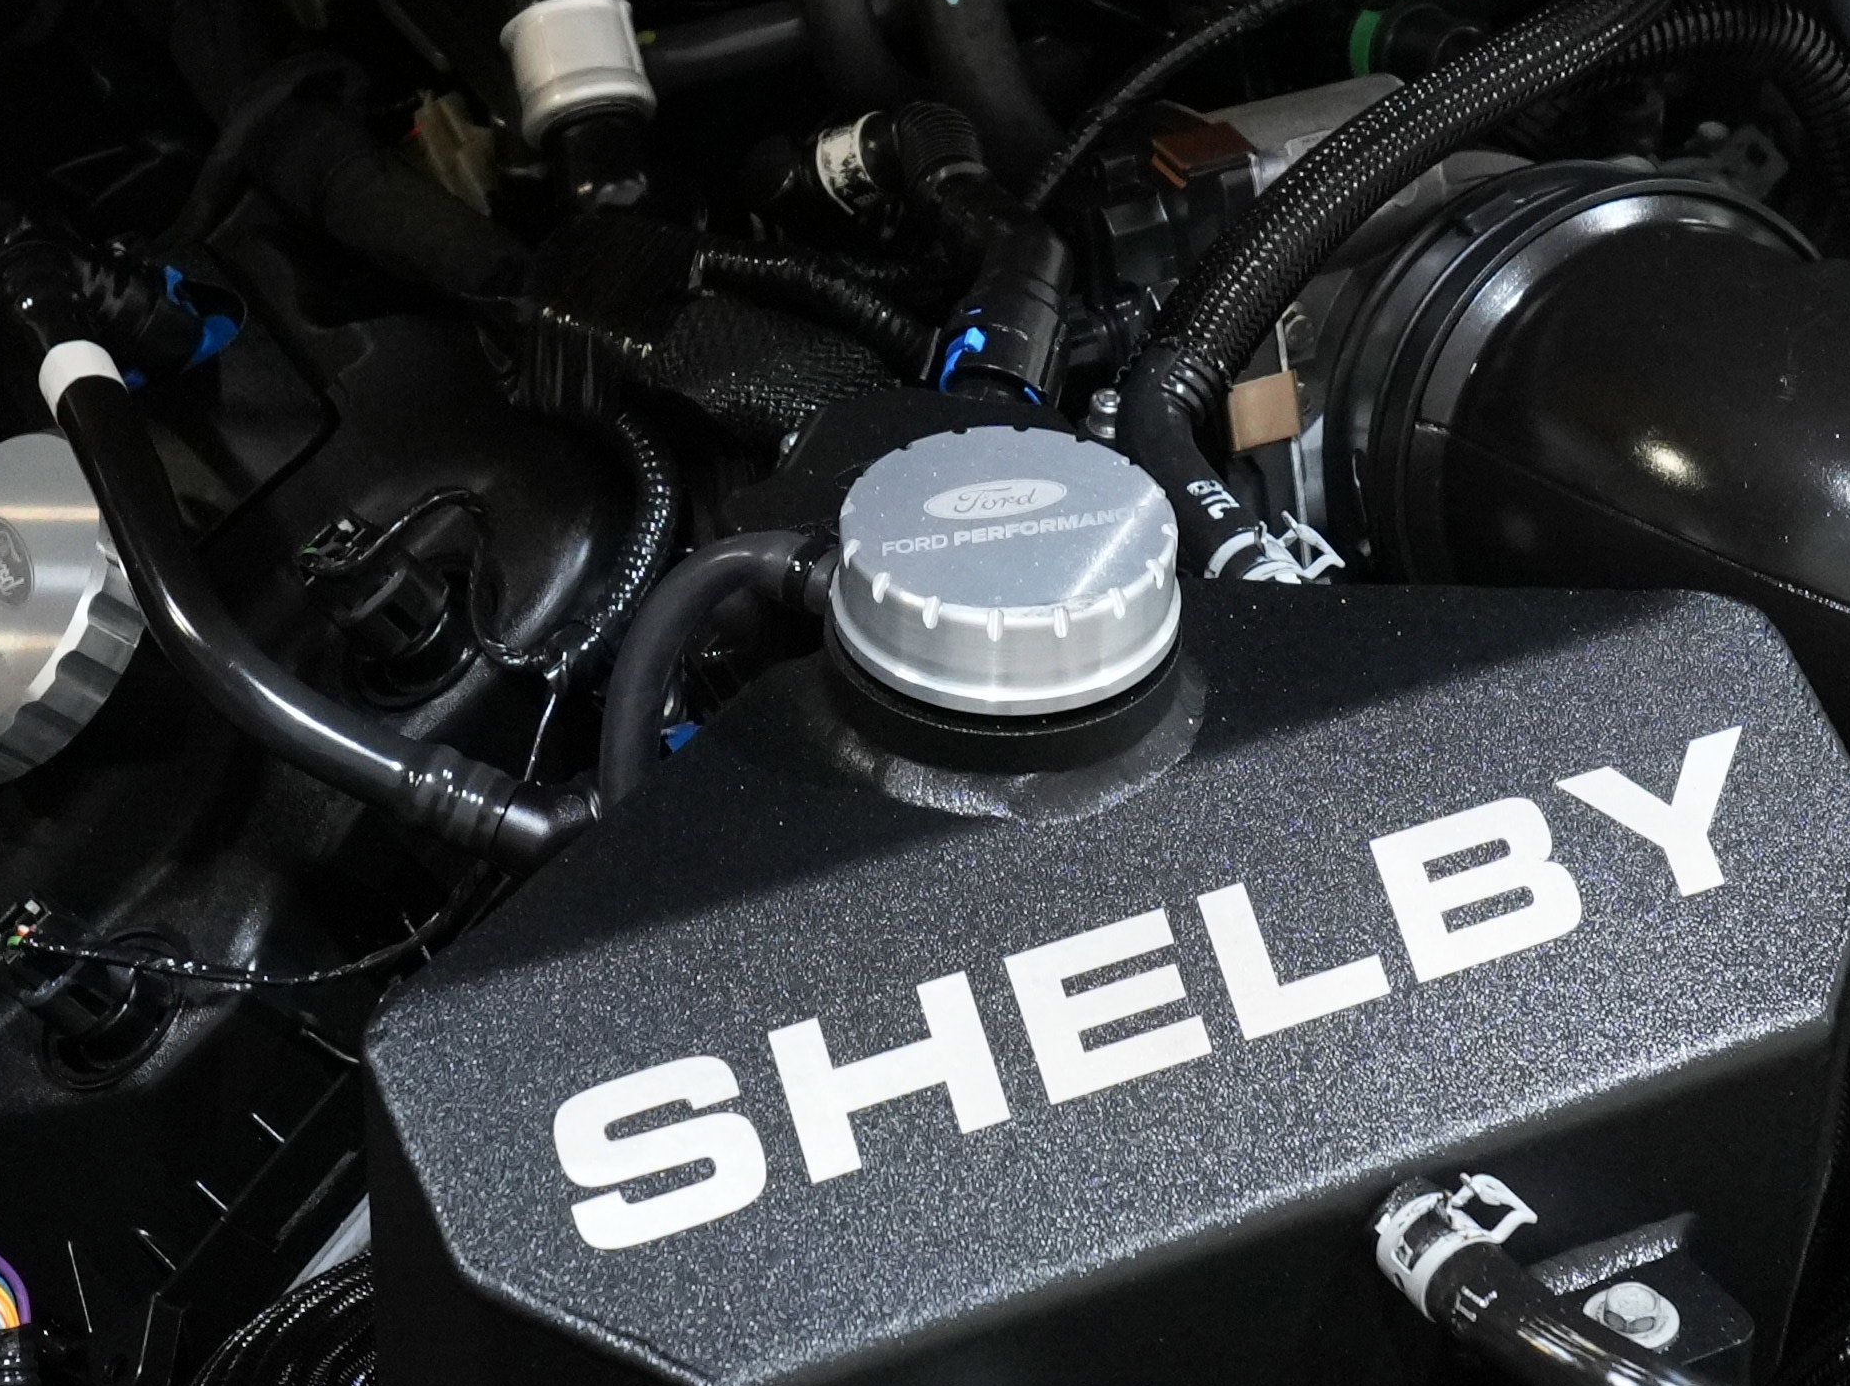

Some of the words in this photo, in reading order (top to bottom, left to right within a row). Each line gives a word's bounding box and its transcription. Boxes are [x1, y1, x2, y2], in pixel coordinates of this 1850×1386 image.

[953, 487, 1037, 514] Ford
[881, 532, 948, 557] FORD
[552, 726, 1742, 1251] SHELBY
